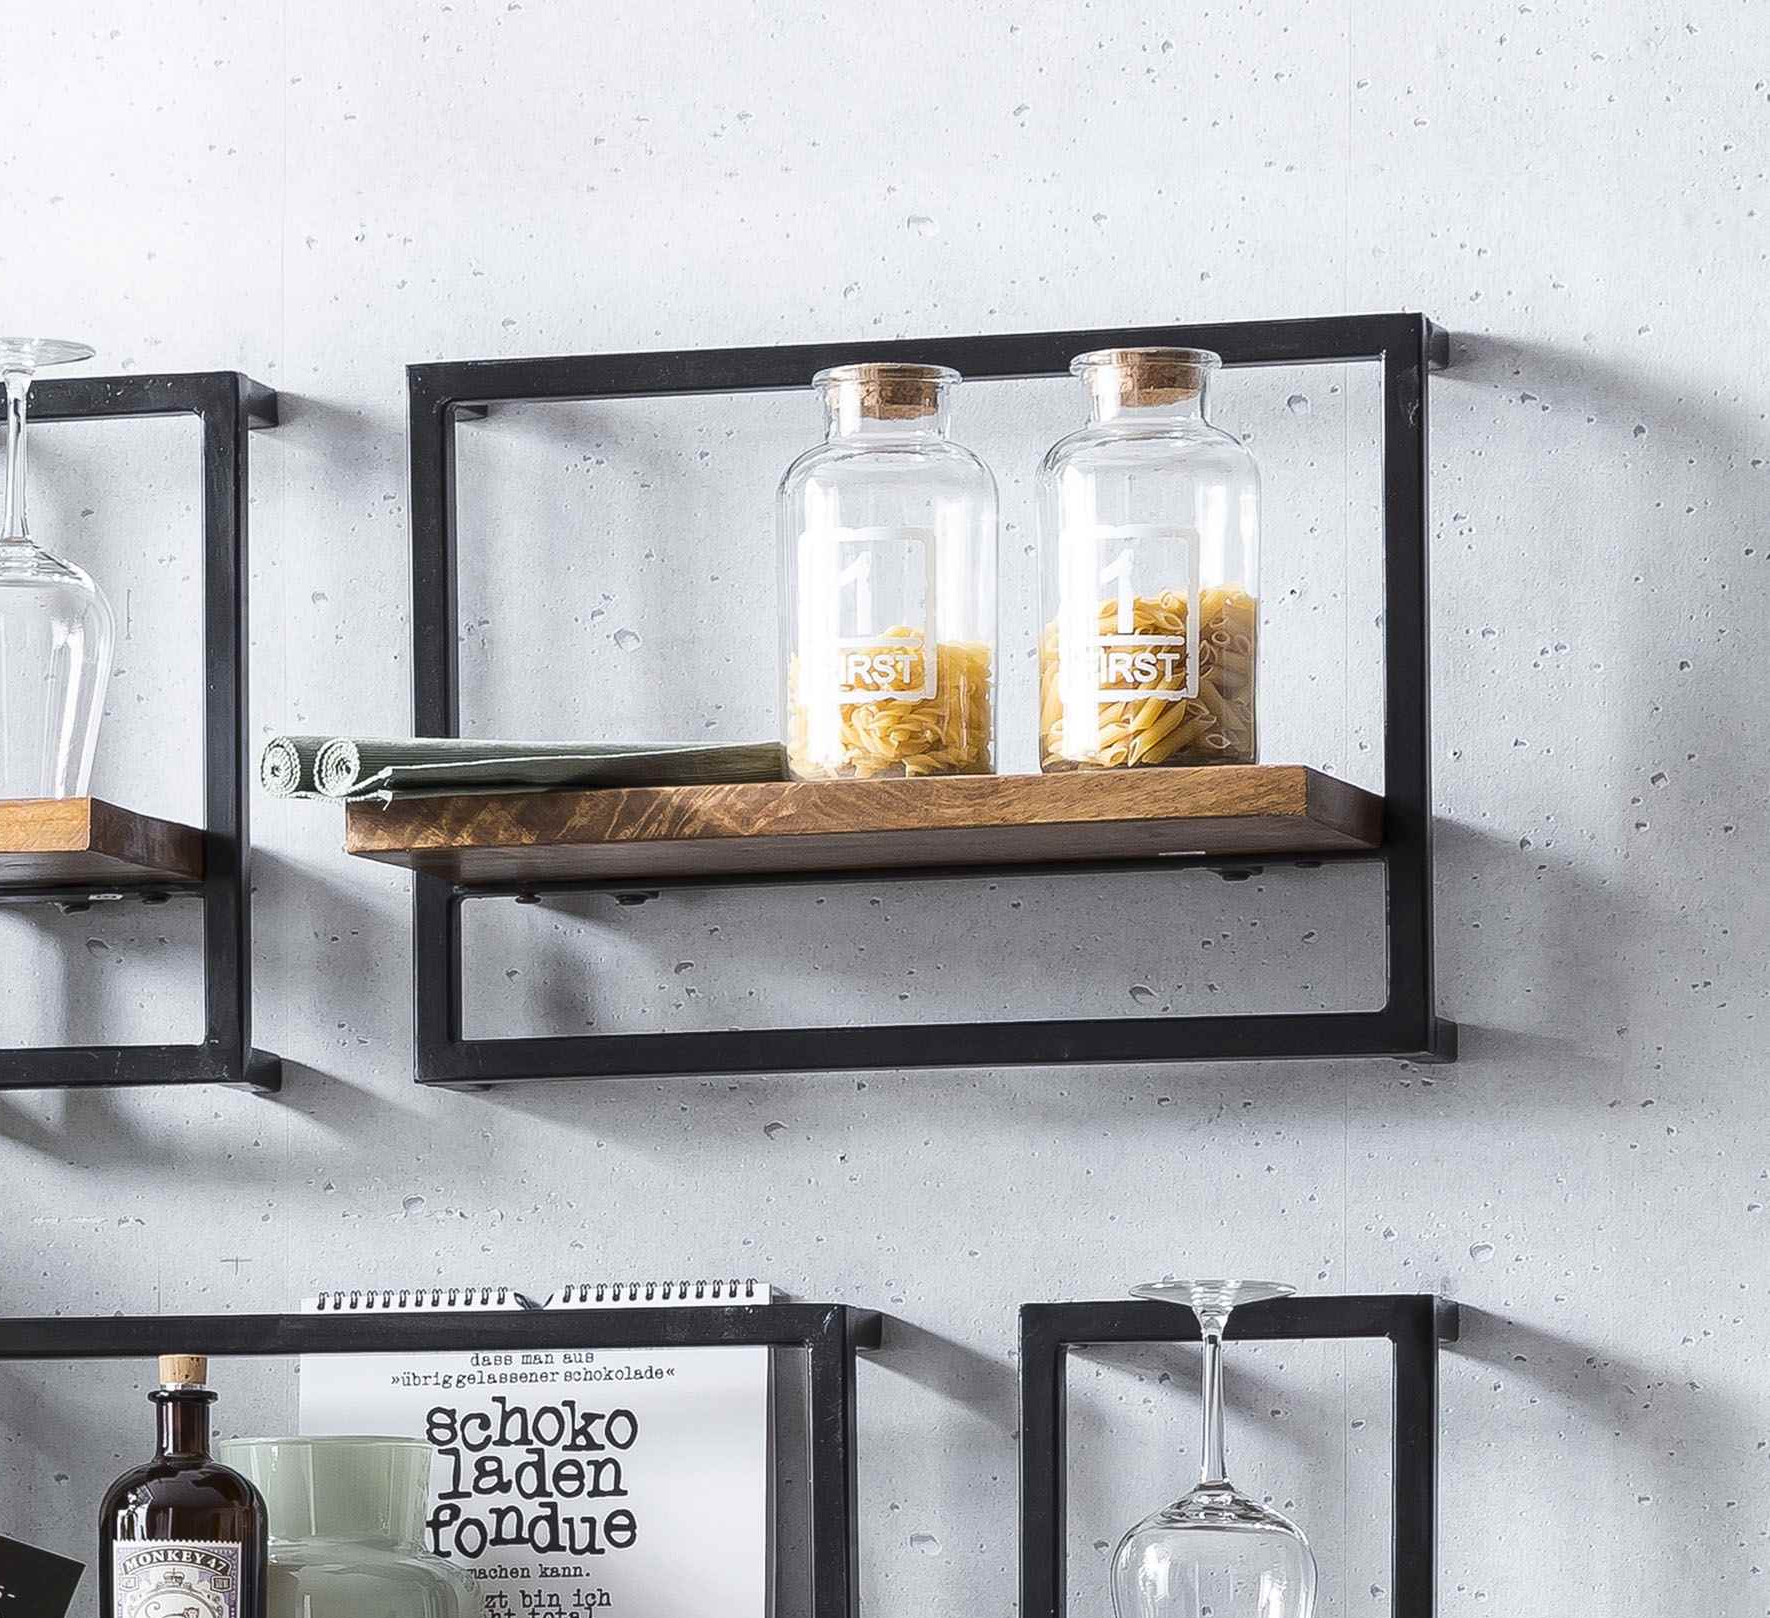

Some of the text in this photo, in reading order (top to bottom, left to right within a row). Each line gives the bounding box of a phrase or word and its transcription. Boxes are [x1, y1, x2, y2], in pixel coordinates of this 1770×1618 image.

[1100, 652, 1180, 683] IRST
[470, 1352, 595, 1367] dass man aus
[564, 1366, 676, 1382] schokolade«
[426, 1396, 638, 1452] schoko
[438, 1447, 628, 1500] laden
[426, 1502, 637, 1559] fondue
[125, 1549, 227, 1572] MONKEY 47
[538, 1564, 591, 1578] kann.
[519, 1590, 561, 1608] bin
[572, 1588, 612, 1607] ich
